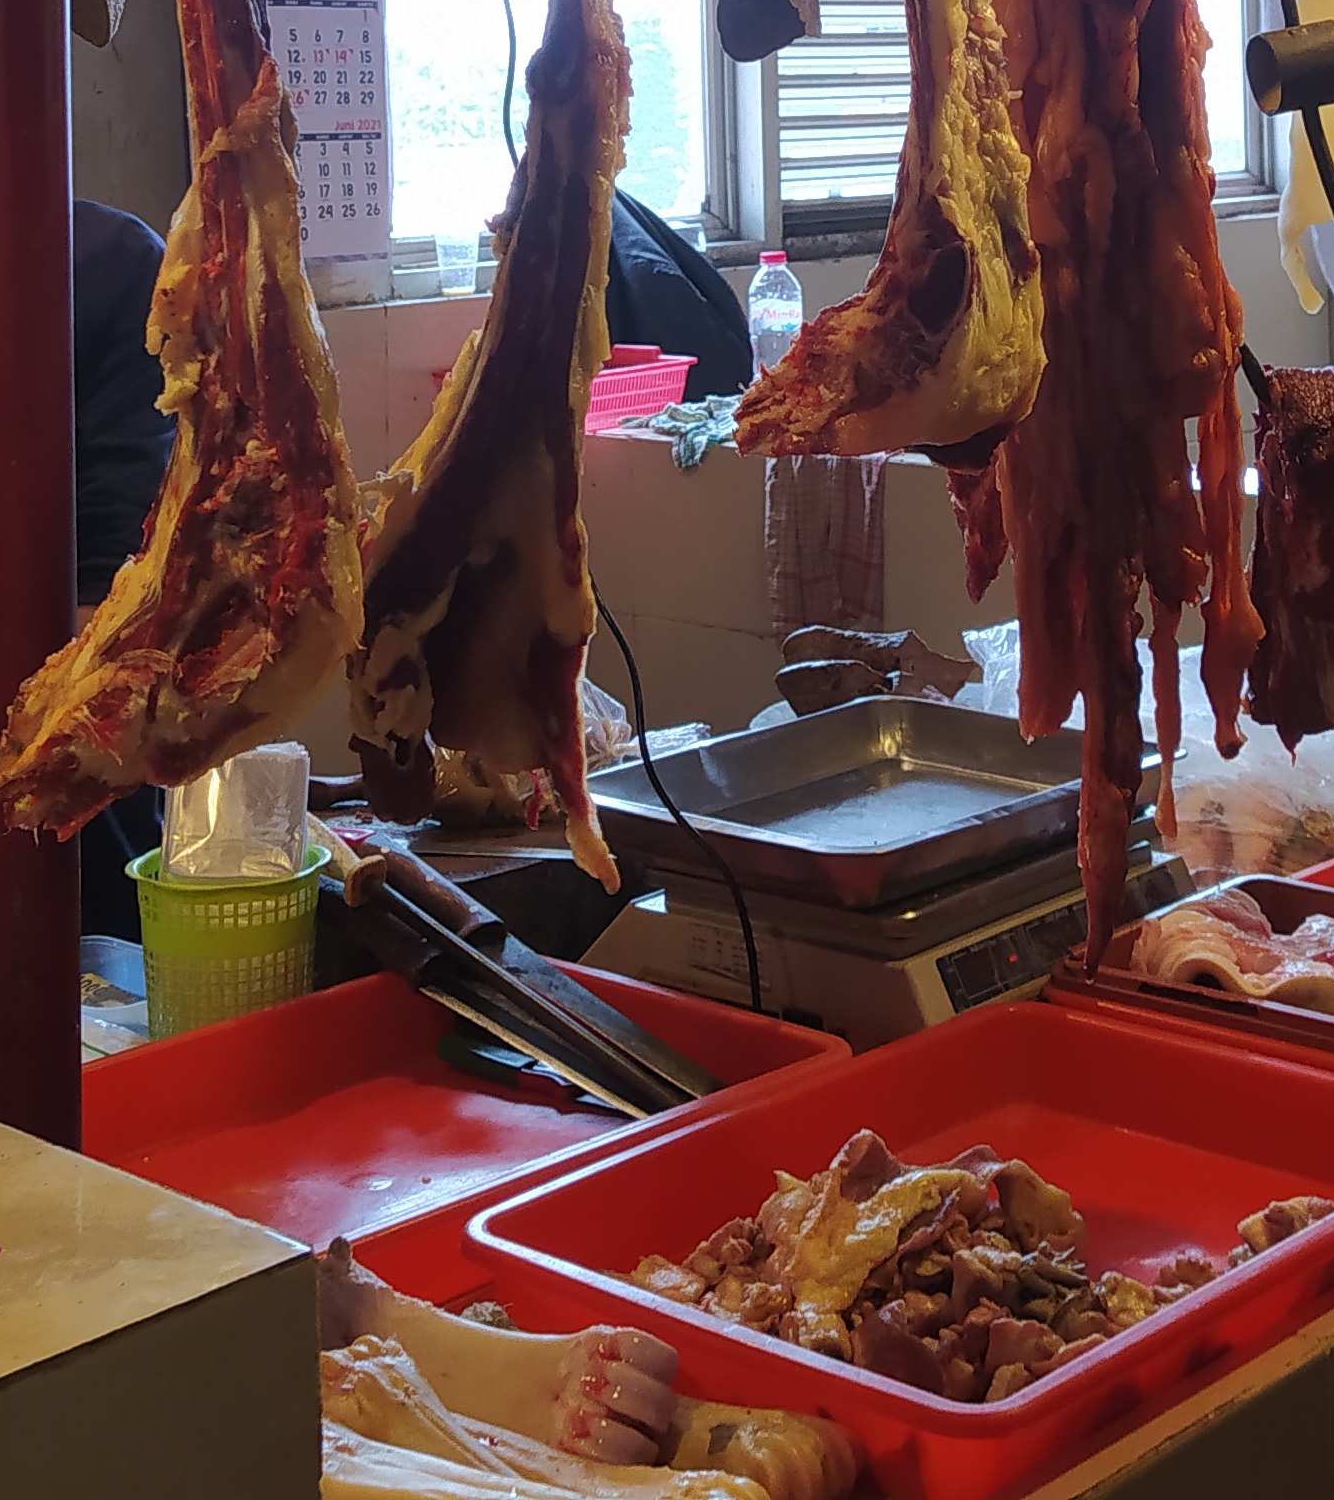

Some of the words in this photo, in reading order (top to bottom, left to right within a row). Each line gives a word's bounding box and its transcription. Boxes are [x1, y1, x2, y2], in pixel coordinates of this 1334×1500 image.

[362, 10, 367, 23] 1
[289, 29, 297, 42] 5
[315, 29, 322, 42] 6
[336, 30, 344, 43] 7
[362, 30, 369, 43] 8
[287, 50, 300, 63] 12
[313, 50, 324, 63] 13
[335, 51, 347, 63] 14
[360, 50, 372, 63] 15
[288, 70, 301, 84] 19
[313, 71, 327, 84] 20
[336, 71, 347, 84] 21
[359, 71, 374, 84] 22
[314, 91, 327, 105] 27
[336, 91, 350, 105] 28
[360, 91, 374, 105] 29
[335, 121, 354, 131] Juni
[358, 120, 381, 130] 2021
[295, 143, 301, 157] 2
[320, 143, 326, 156] 3
[342, 142, 350, 155] 4
[365, 142, 373, 155] 5
[319, 163, 329, 177] 10
[342, 163, 351, 176] 11
[365, 162, 376, 175] 12
[319, 184, 330, 198] 17
[342, 184, 354, 196] 18
[366, 182, 377, 195] 19
[300, 206, 306, 220] 3
[318, 205, 333, 219] 24
[342, 204, 356, 217] 25
[366, 203, 380, 216] 26
[301, 227, 308, 241] 0
